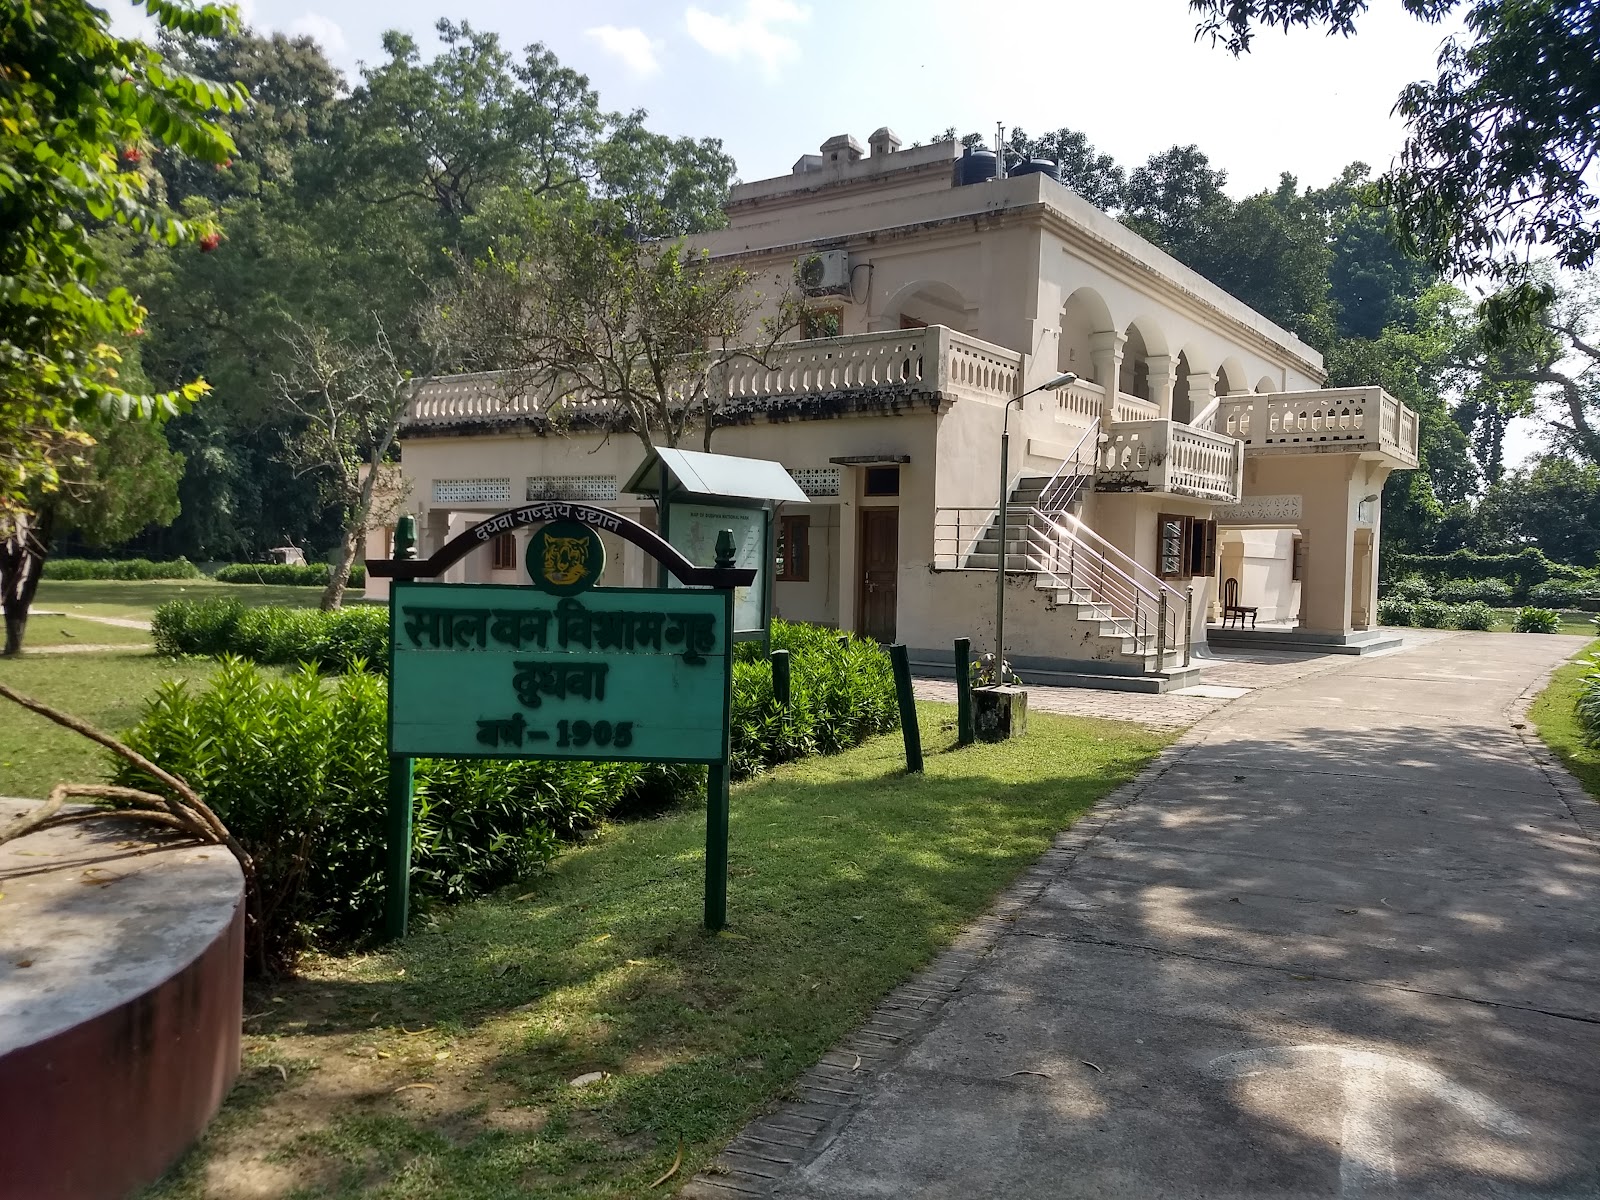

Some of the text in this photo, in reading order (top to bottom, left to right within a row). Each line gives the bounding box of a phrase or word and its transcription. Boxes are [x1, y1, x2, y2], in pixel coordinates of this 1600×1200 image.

[474, 502, 623, 541] दुधवा राष्ट्रीय उद्यान
[512, 661, 609, 708] दुधवा
